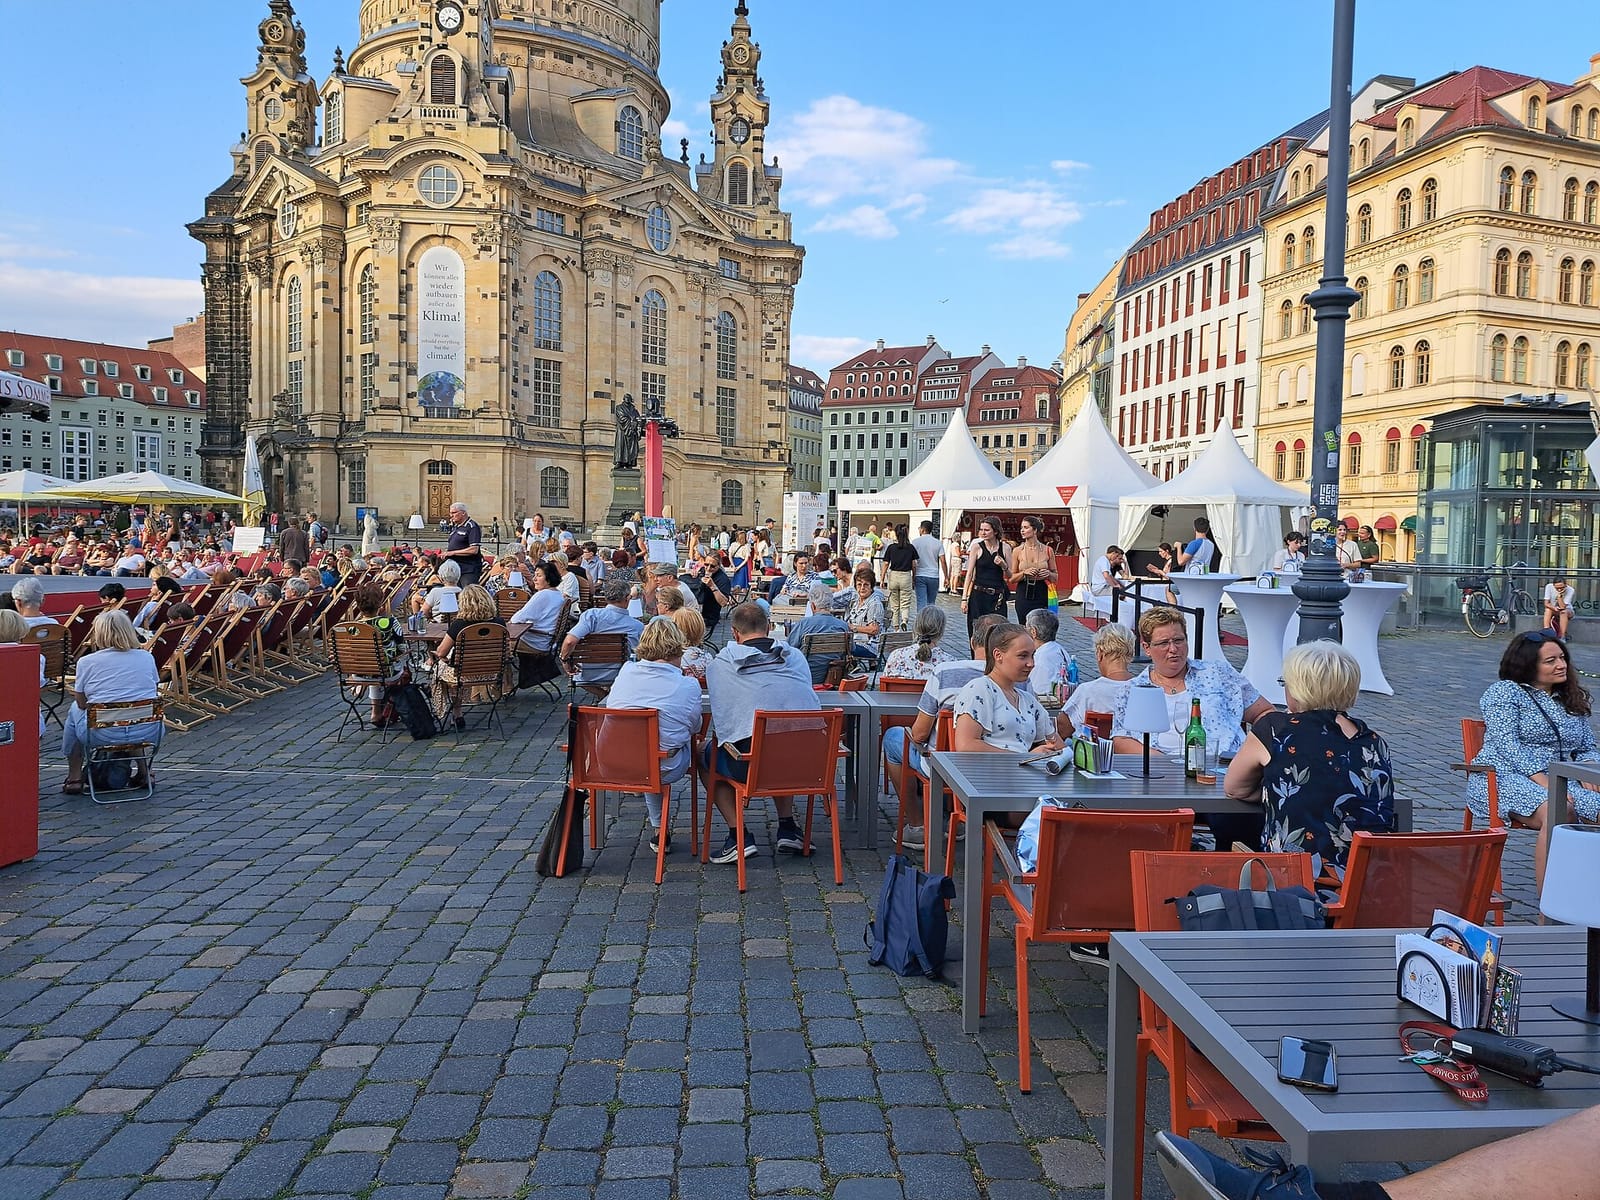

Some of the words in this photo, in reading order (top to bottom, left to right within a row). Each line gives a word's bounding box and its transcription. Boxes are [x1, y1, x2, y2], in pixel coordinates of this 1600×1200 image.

[422, 310, 461, 322] Klima!
[426, 352, 457, 361] climate!
[1174, 440, 1191, 449] Lounge
[972, 495, 987, 503] INFO
[992, 494, 1031, 502] KUNSTMARKT
